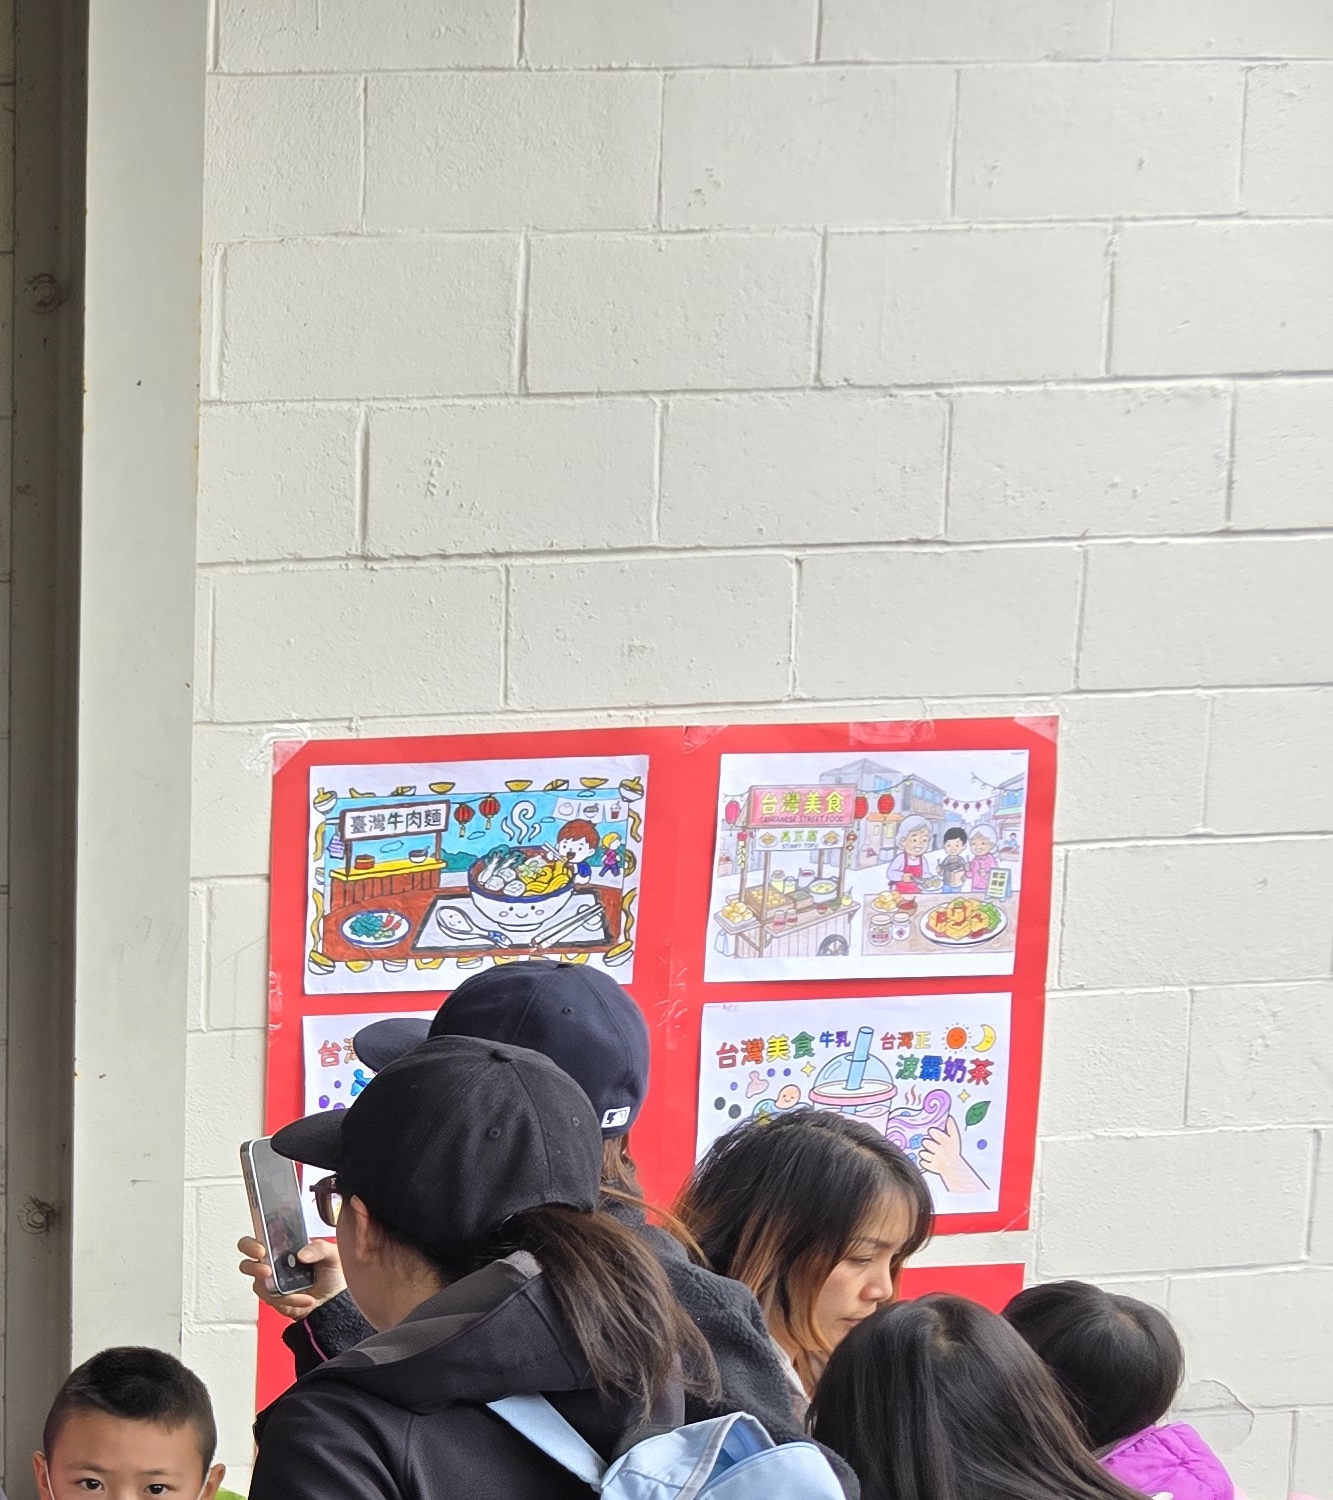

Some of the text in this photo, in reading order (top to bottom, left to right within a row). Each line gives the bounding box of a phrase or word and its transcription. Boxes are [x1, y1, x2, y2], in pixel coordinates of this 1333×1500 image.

[761, 790, 844, 815] 台灣美食
[716, 1030, 851, 1069] 台灣美食 牛乳
[880, 1031, 931, 1050] 台灣正
[895, 1054, 994, 1086] 波霸奶茶
